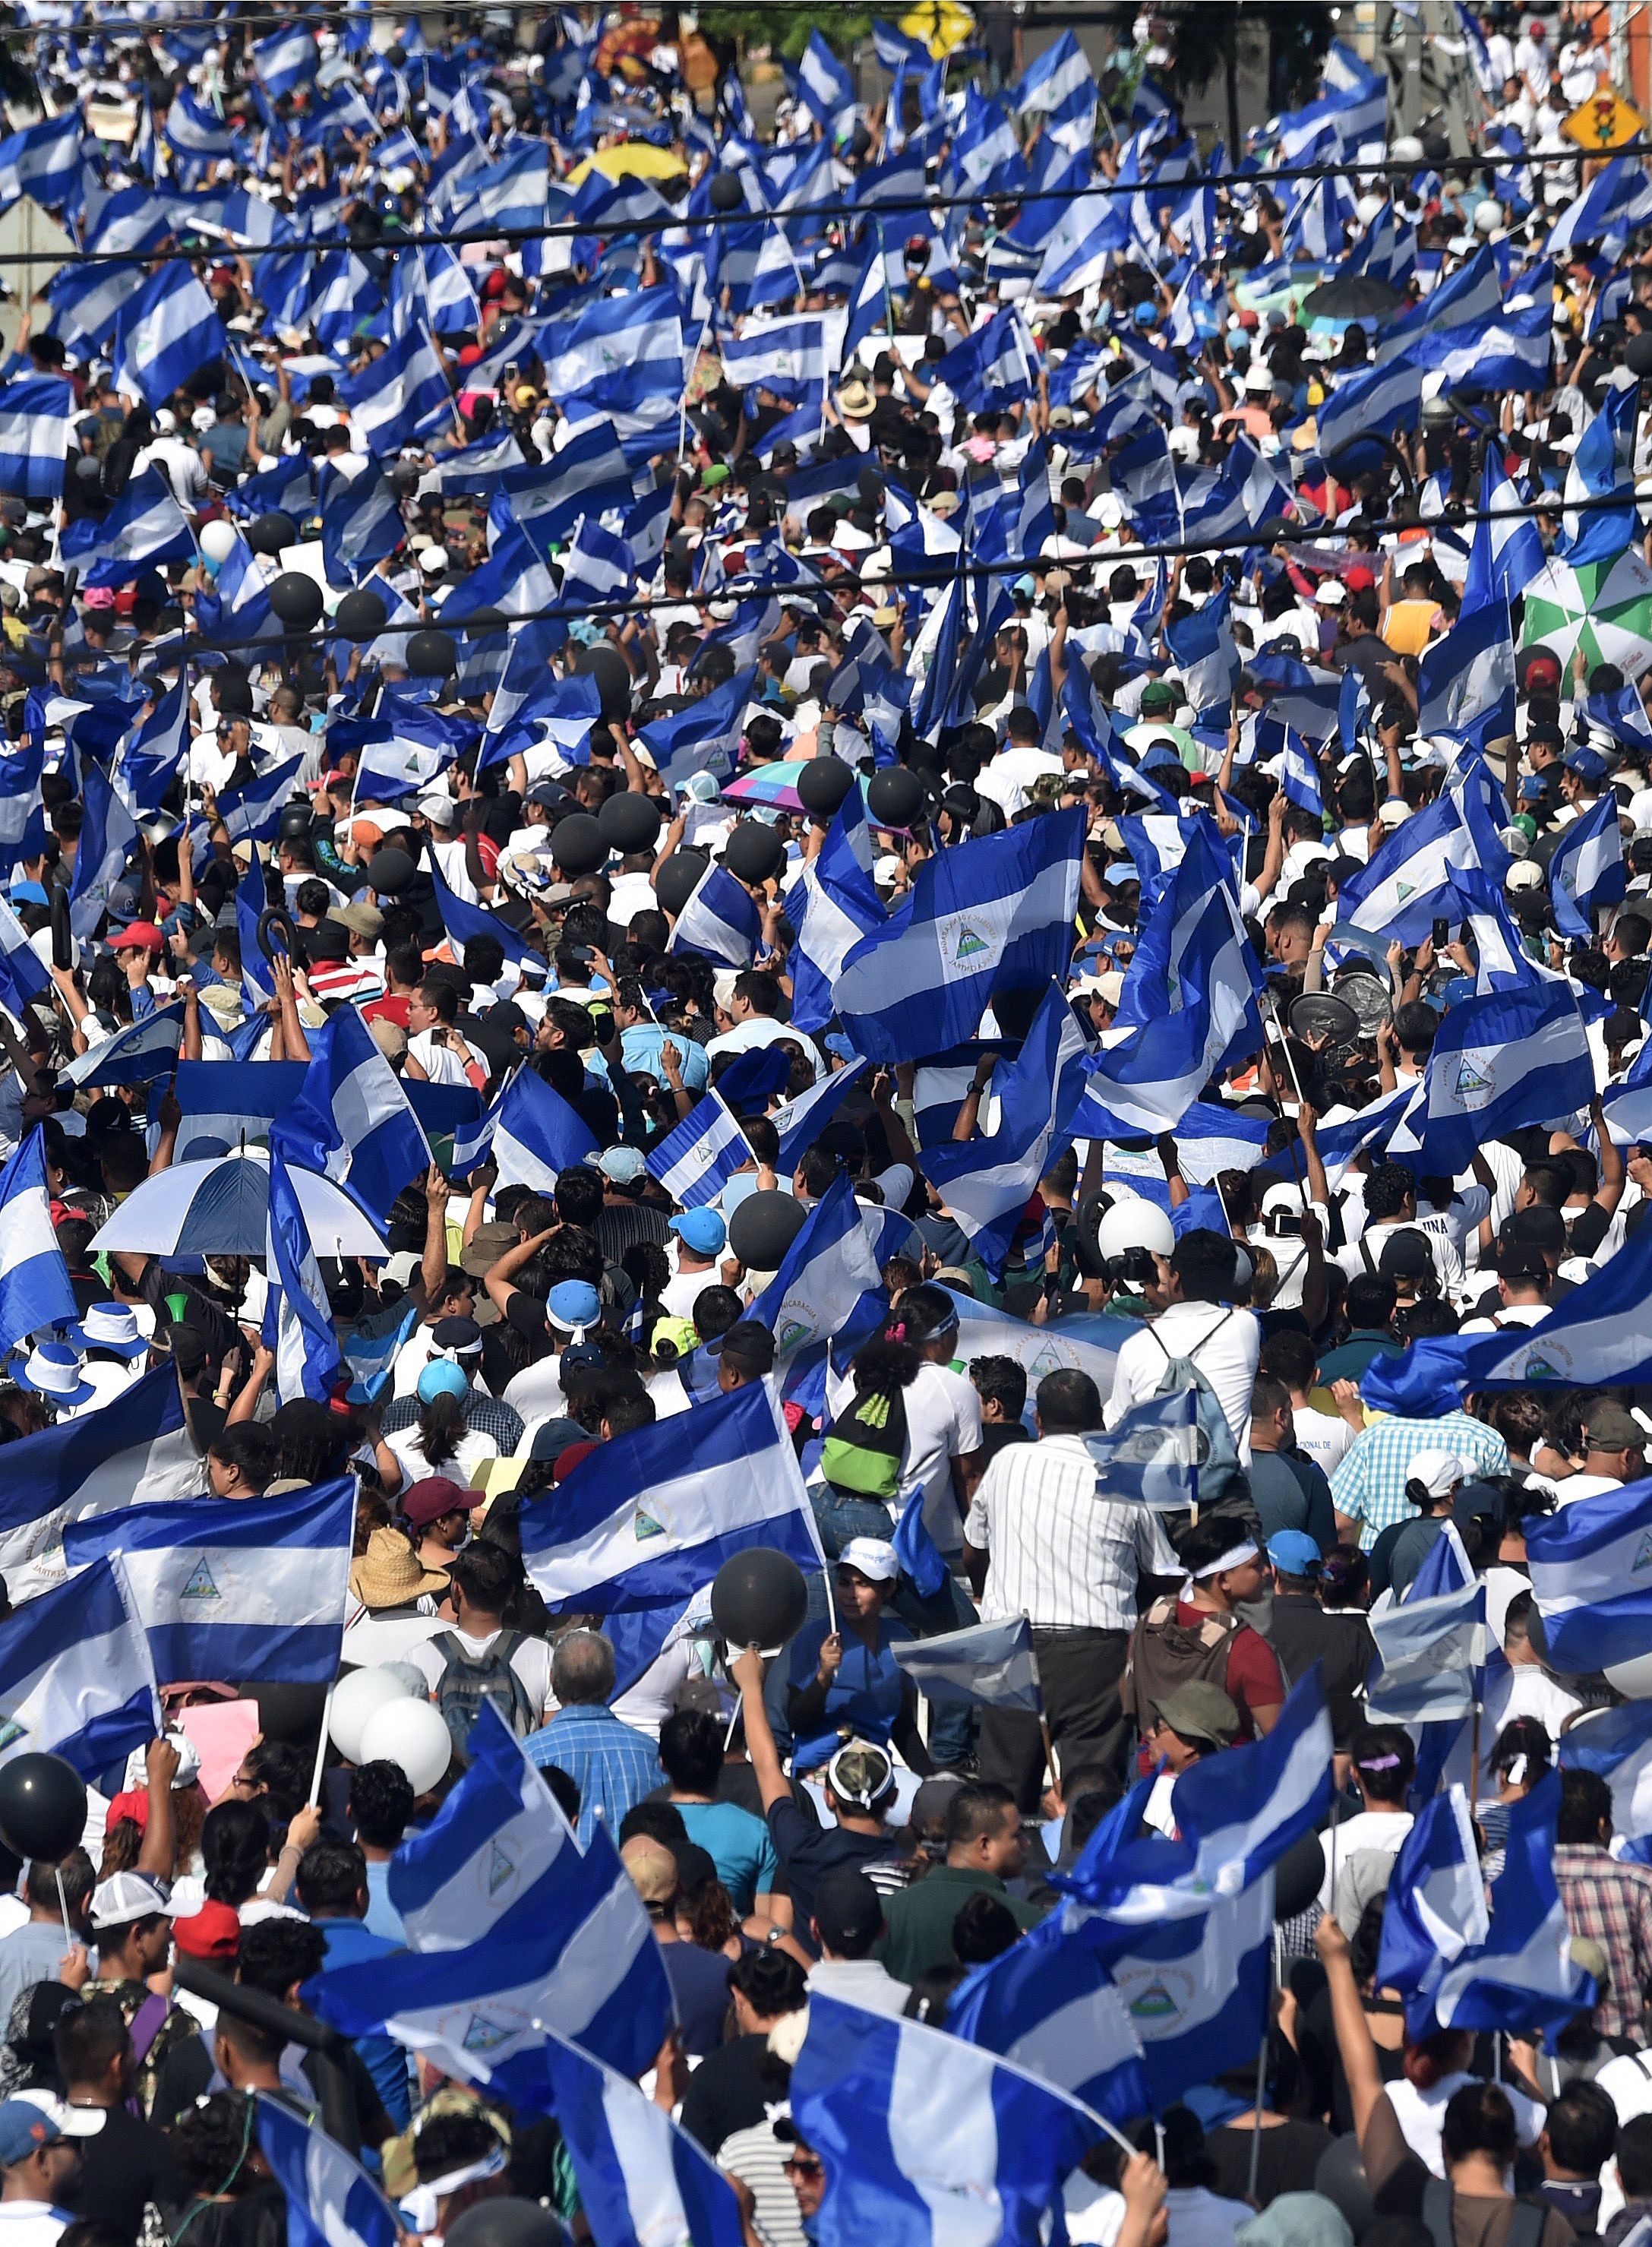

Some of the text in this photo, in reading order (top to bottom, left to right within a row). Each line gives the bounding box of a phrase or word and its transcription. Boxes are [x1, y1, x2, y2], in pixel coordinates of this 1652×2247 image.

[1620, 651, 1644, 671] Toña
[782, 1300, 817, 1319] NICARAGUA
[1323, 1440, 1331, 1449] DE
